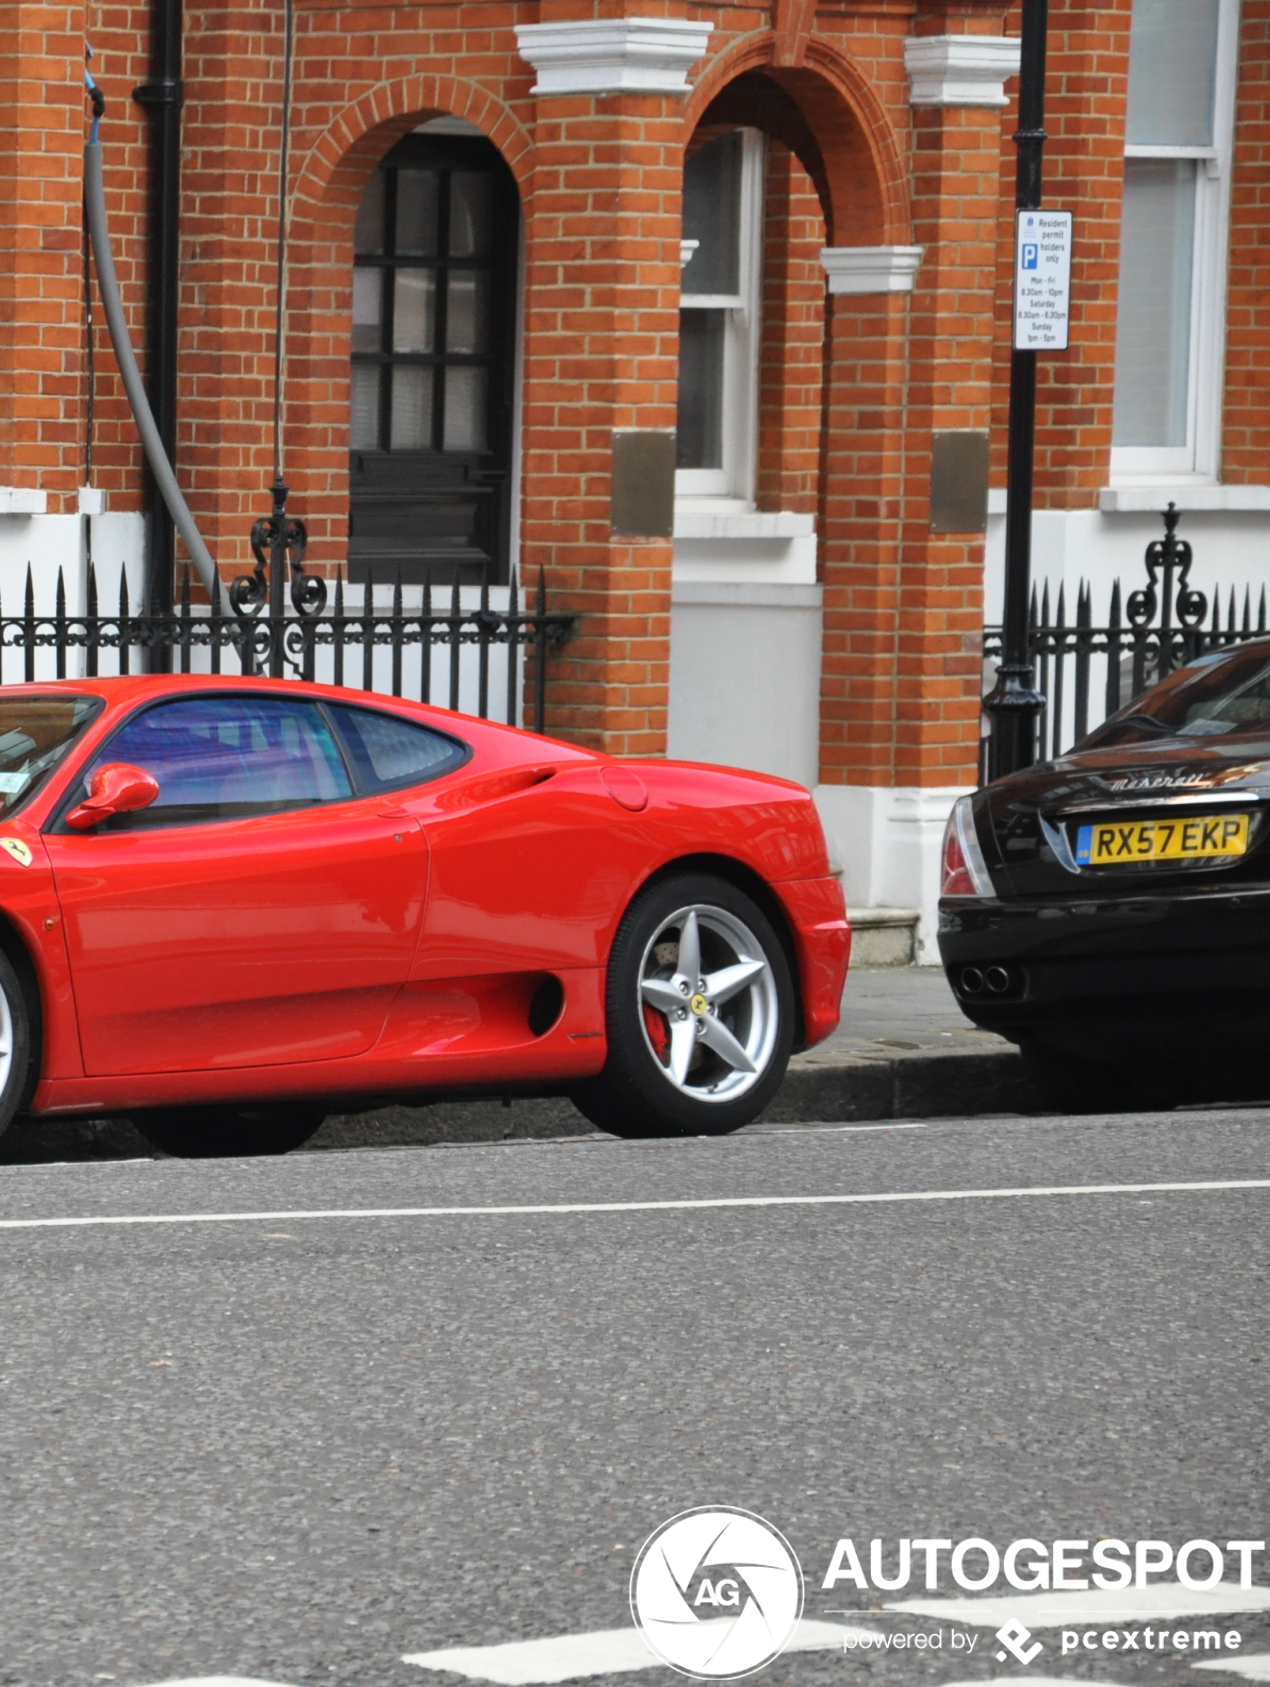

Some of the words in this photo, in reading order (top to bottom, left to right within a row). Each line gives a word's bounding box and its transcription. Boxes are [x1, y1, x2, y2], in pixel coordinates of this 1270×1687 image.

[1039, 218, 1068, 228] Resident
[1042, 230, 1064, 240] permit
[1040, 242, 1065, 252] holders
[1024, 245, 1036, 268] P
[1046, 254, 1059, 264] only
[1031, 276, 1043, 284] Mon
[1048, 276, 1056, 284] Fri
[1021, 288, 1043, 296] 8.30am
[1048, 288, 1063, 297] 10pm
[1030, 299, 1055, 309] Saturday
[1018, 311, 1040, 319] 8.30am
[1045, 310, 1067, 320] 6.30pm
[1032, 322, 1052, 332] Sunday
[1028, 334, 1038, 343] 1pm
[1044, 334, 1056, 343] 5pm
[1097, 825, 1176, 857] RX57
[1181, 820, 1241, 852] EKP
